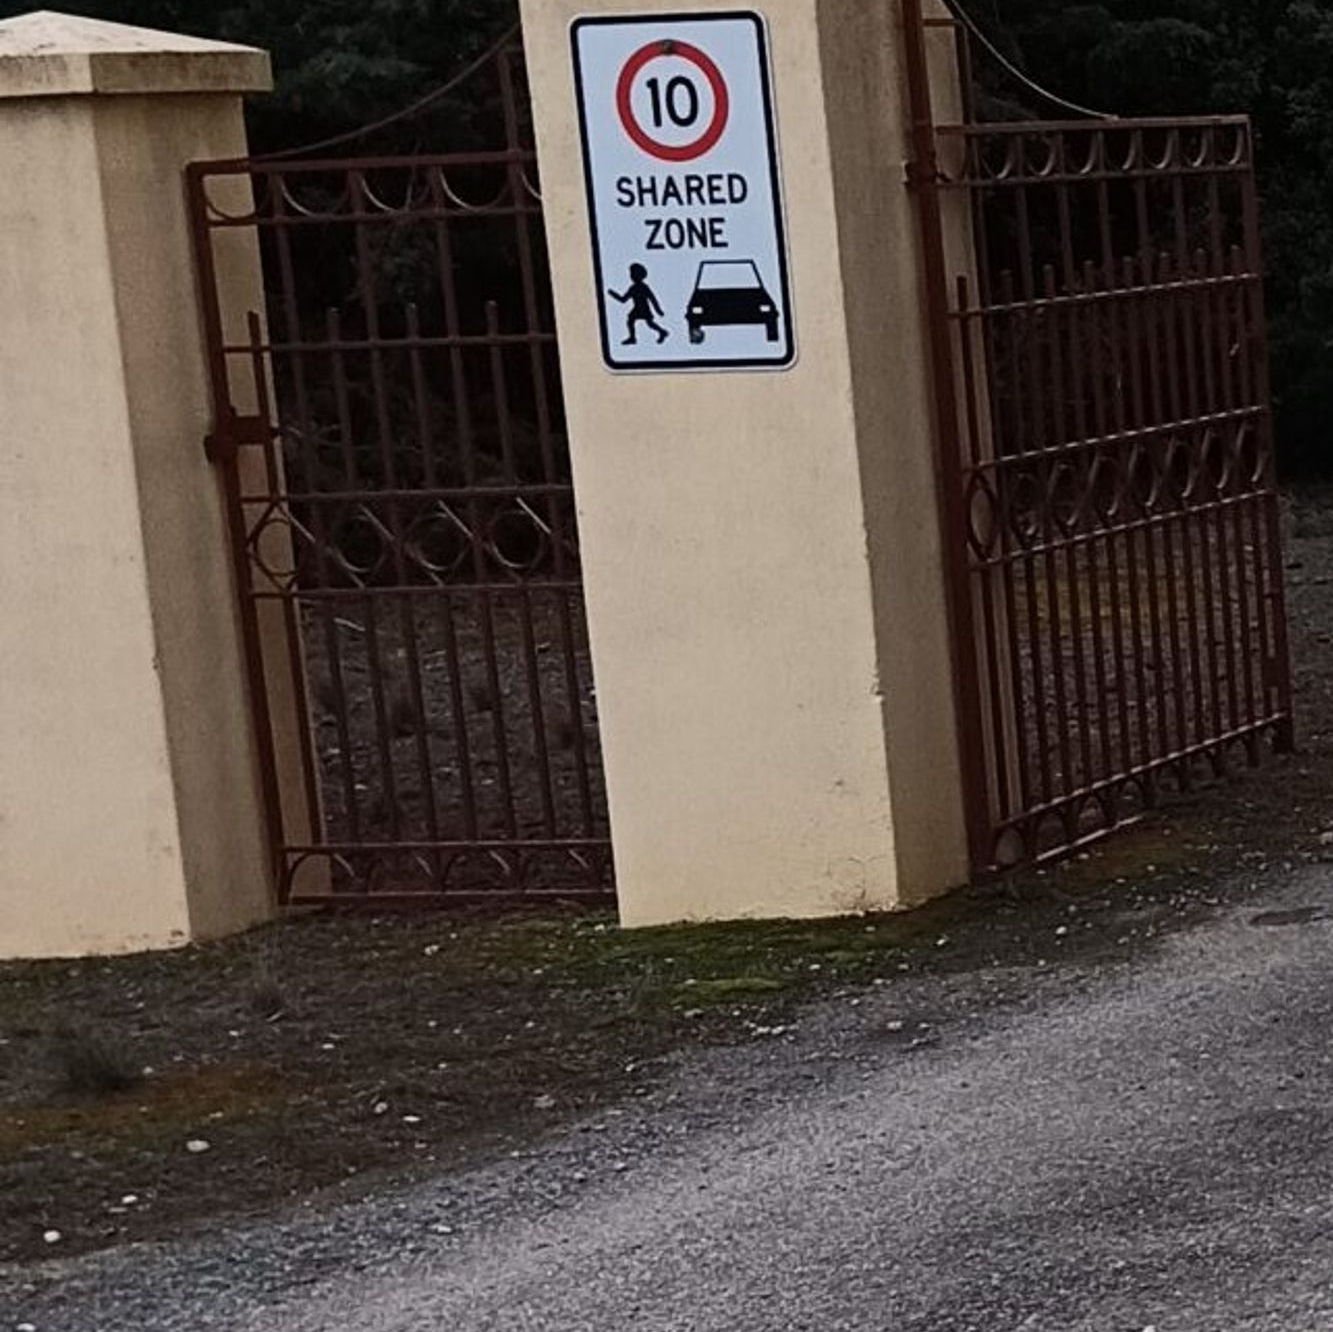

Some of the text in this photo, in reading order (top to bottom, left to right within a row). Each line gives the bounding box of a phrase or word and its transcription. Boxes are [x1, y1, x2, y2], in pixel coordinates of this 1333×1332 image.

[646, 75, 699, 128] 10
[616, 173, 748, 208] SHARED
[644, 217, 729, 250] ZONE
